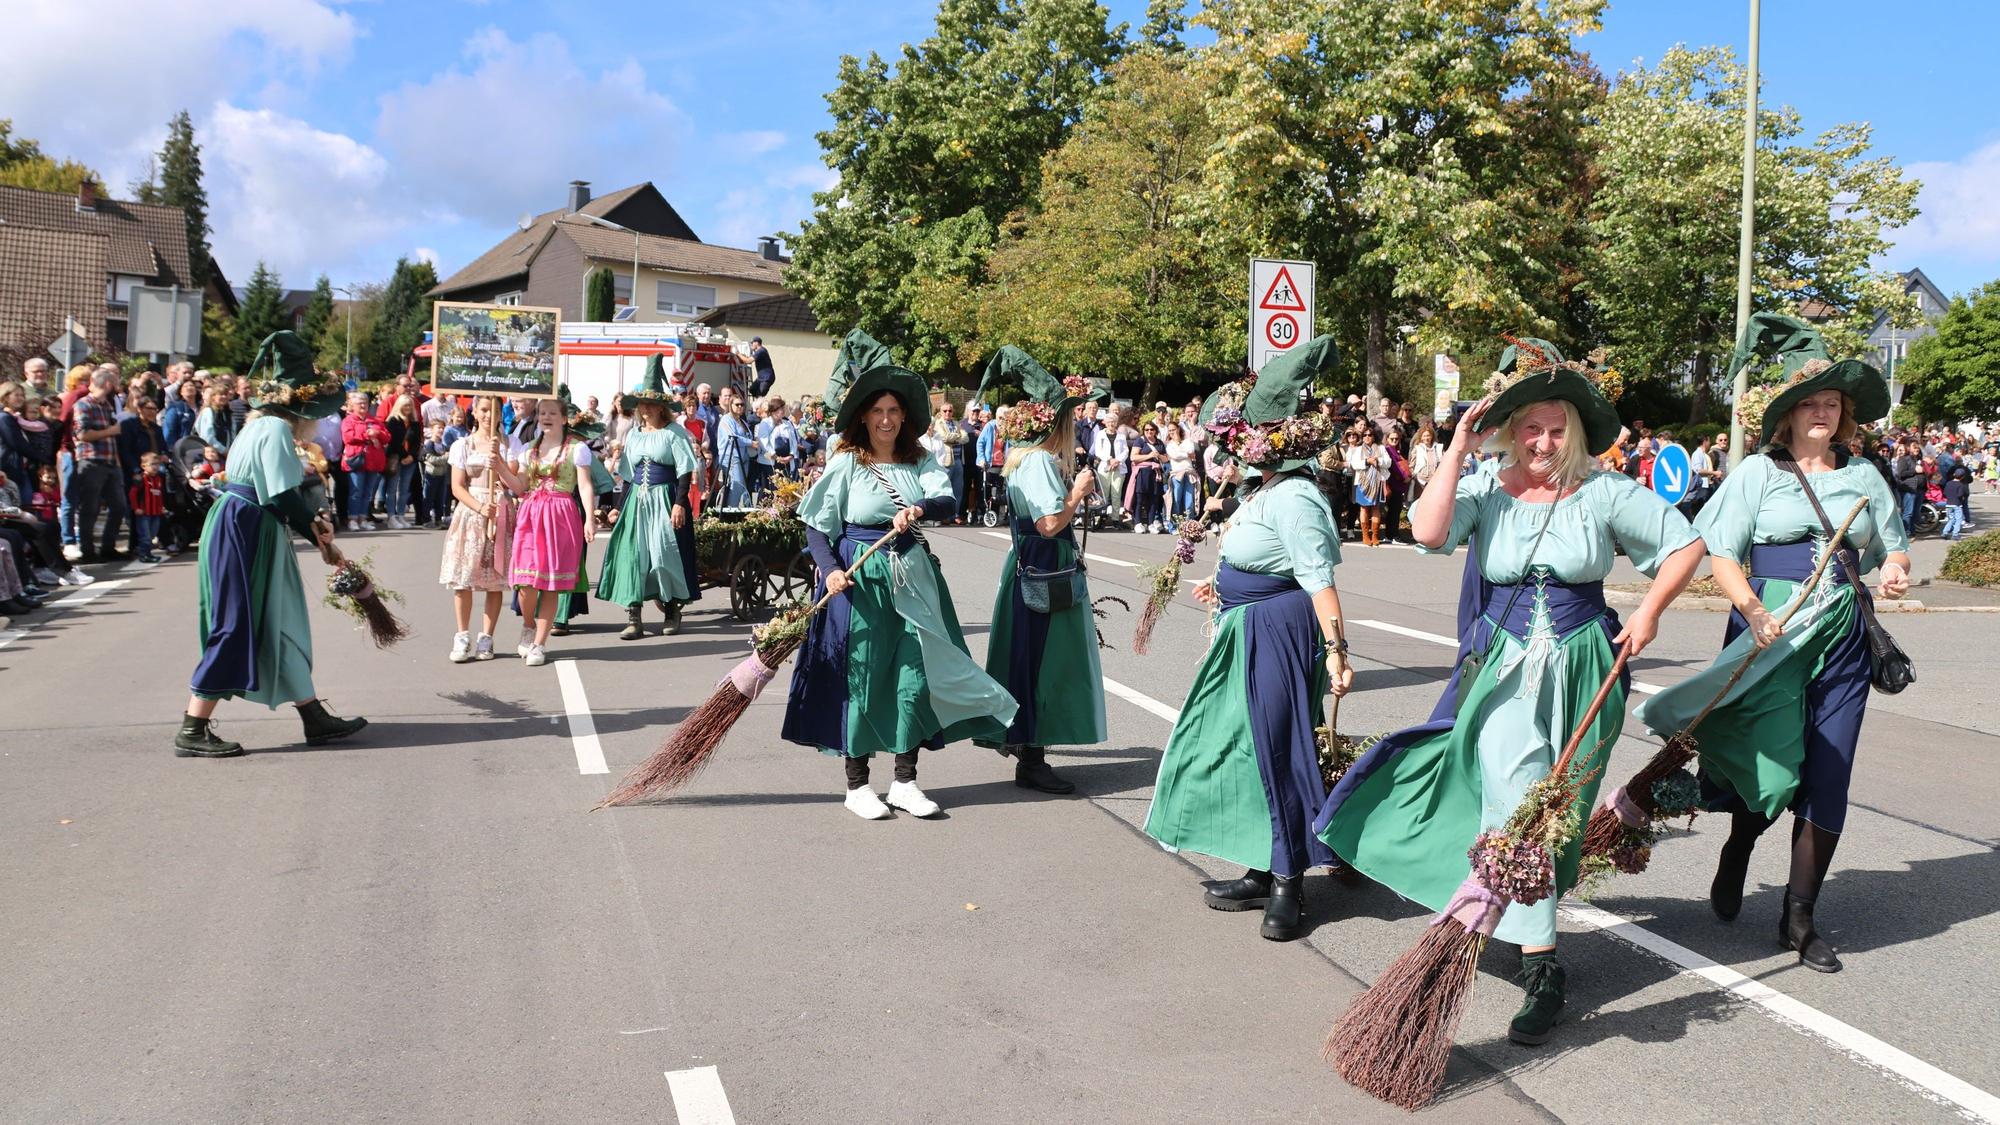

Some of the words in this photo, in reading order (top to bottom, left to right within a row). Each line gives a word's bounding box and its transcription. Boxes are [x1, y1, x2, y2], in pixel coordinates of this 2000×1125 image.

[1273, 322, 1292, 339] 30
[454, 339, 474, 350] Wir
[475, 340, 511, 351] sammeln
[513, 345, 539, 353] unsere
[476, 358, 490, 367] ein
[514, 358, 535, 369] wird
[535, 358, 552, 370] der
[451, 370, 483, 387] Schnaps
[485, 371, 521, 384] besonders
[520, 373, 539, 388] fein
